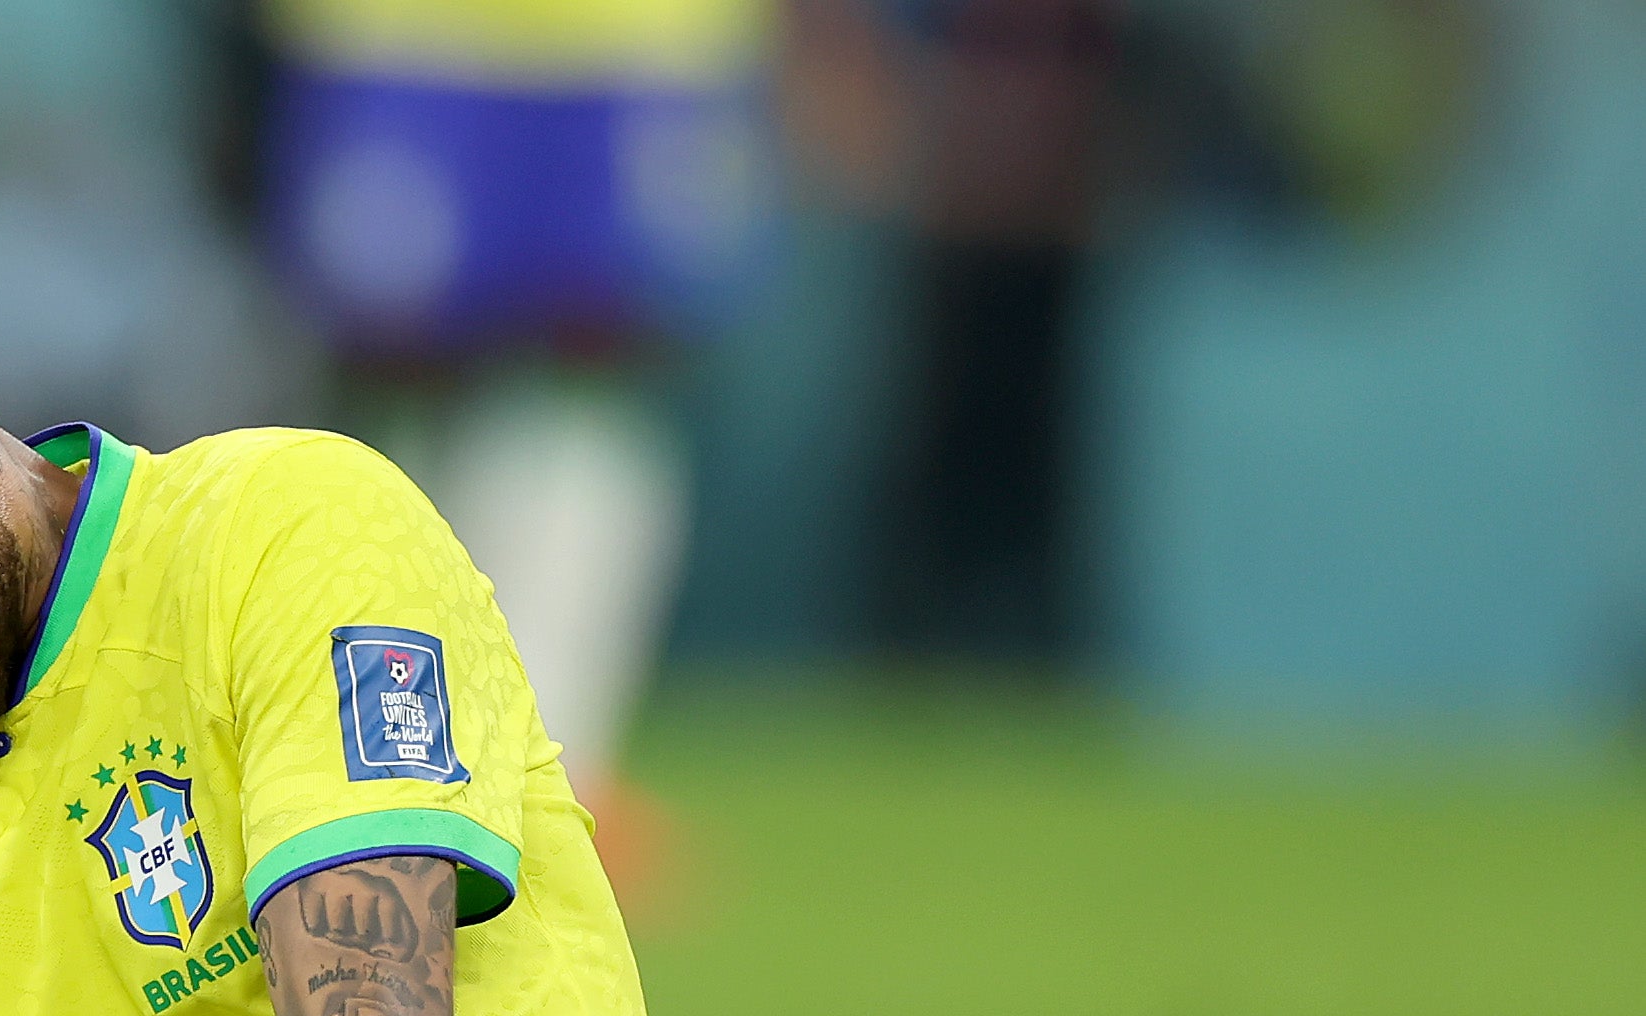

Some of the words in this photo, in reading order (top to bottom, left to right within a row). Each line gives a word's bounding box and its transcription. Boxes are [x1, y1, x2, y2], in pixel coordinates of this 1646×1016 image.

[380, 691, 424, 708] FOOTBALL
[382, 705, 427, 727] UNITES
[402, 726, 433, 746] World
[402, 747, 423, 756] FIFA
[139, 837, 176, 875] CBF
[142, 926, 260, 1014] BRASIL
